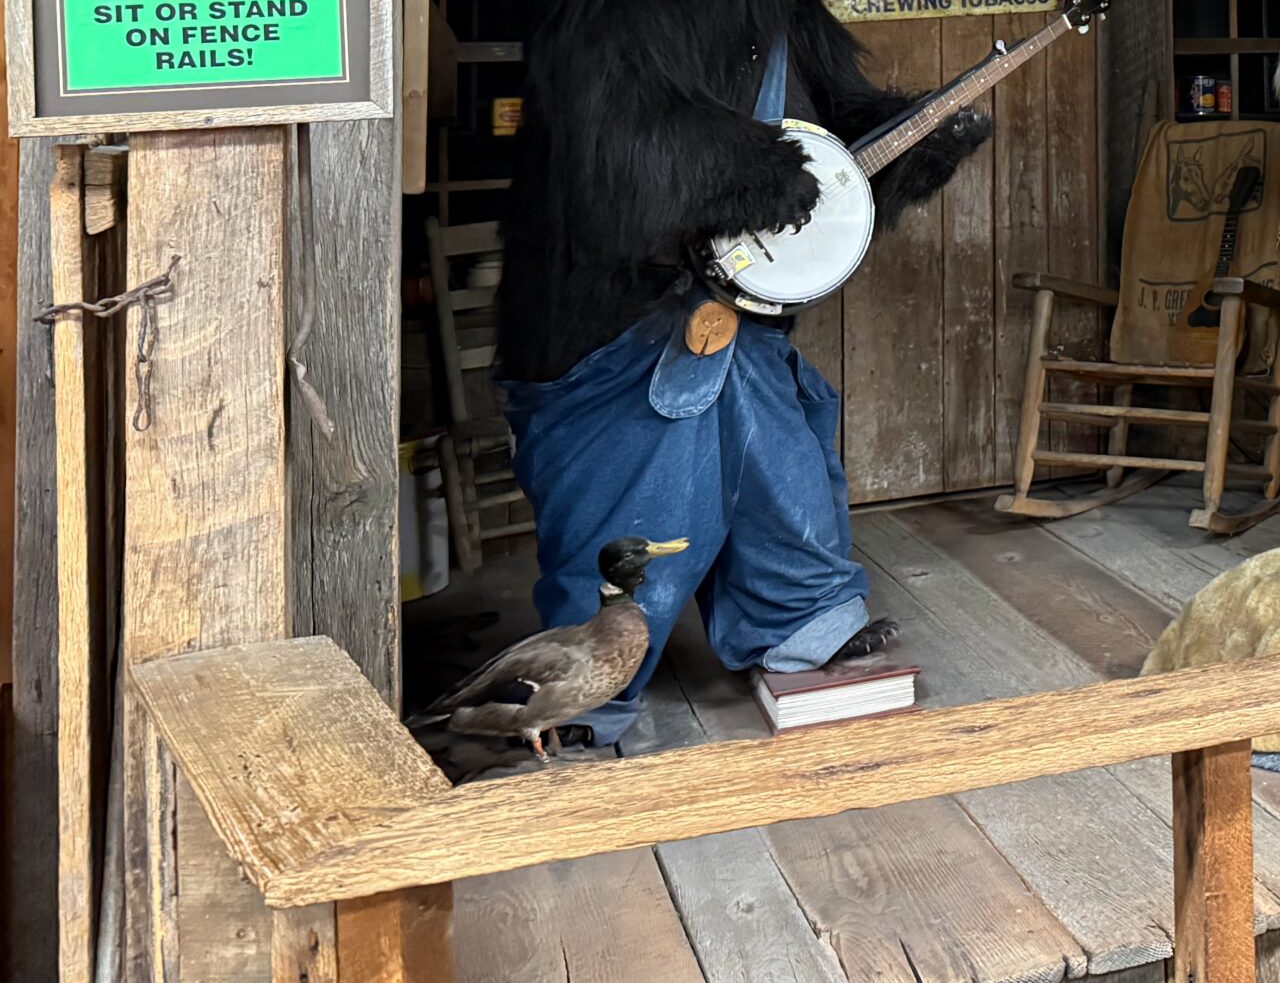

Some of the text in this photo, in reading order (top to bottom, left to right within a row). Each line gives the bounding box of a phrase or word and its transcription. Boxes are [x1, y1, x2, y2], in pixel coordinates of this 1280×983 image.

[93, 4, 144, 24] SIT
[155, 2, 198, 22] OR
[125, 23, 280, 47] ON FENCE
[155, 48, 254, 70] RAILS!
